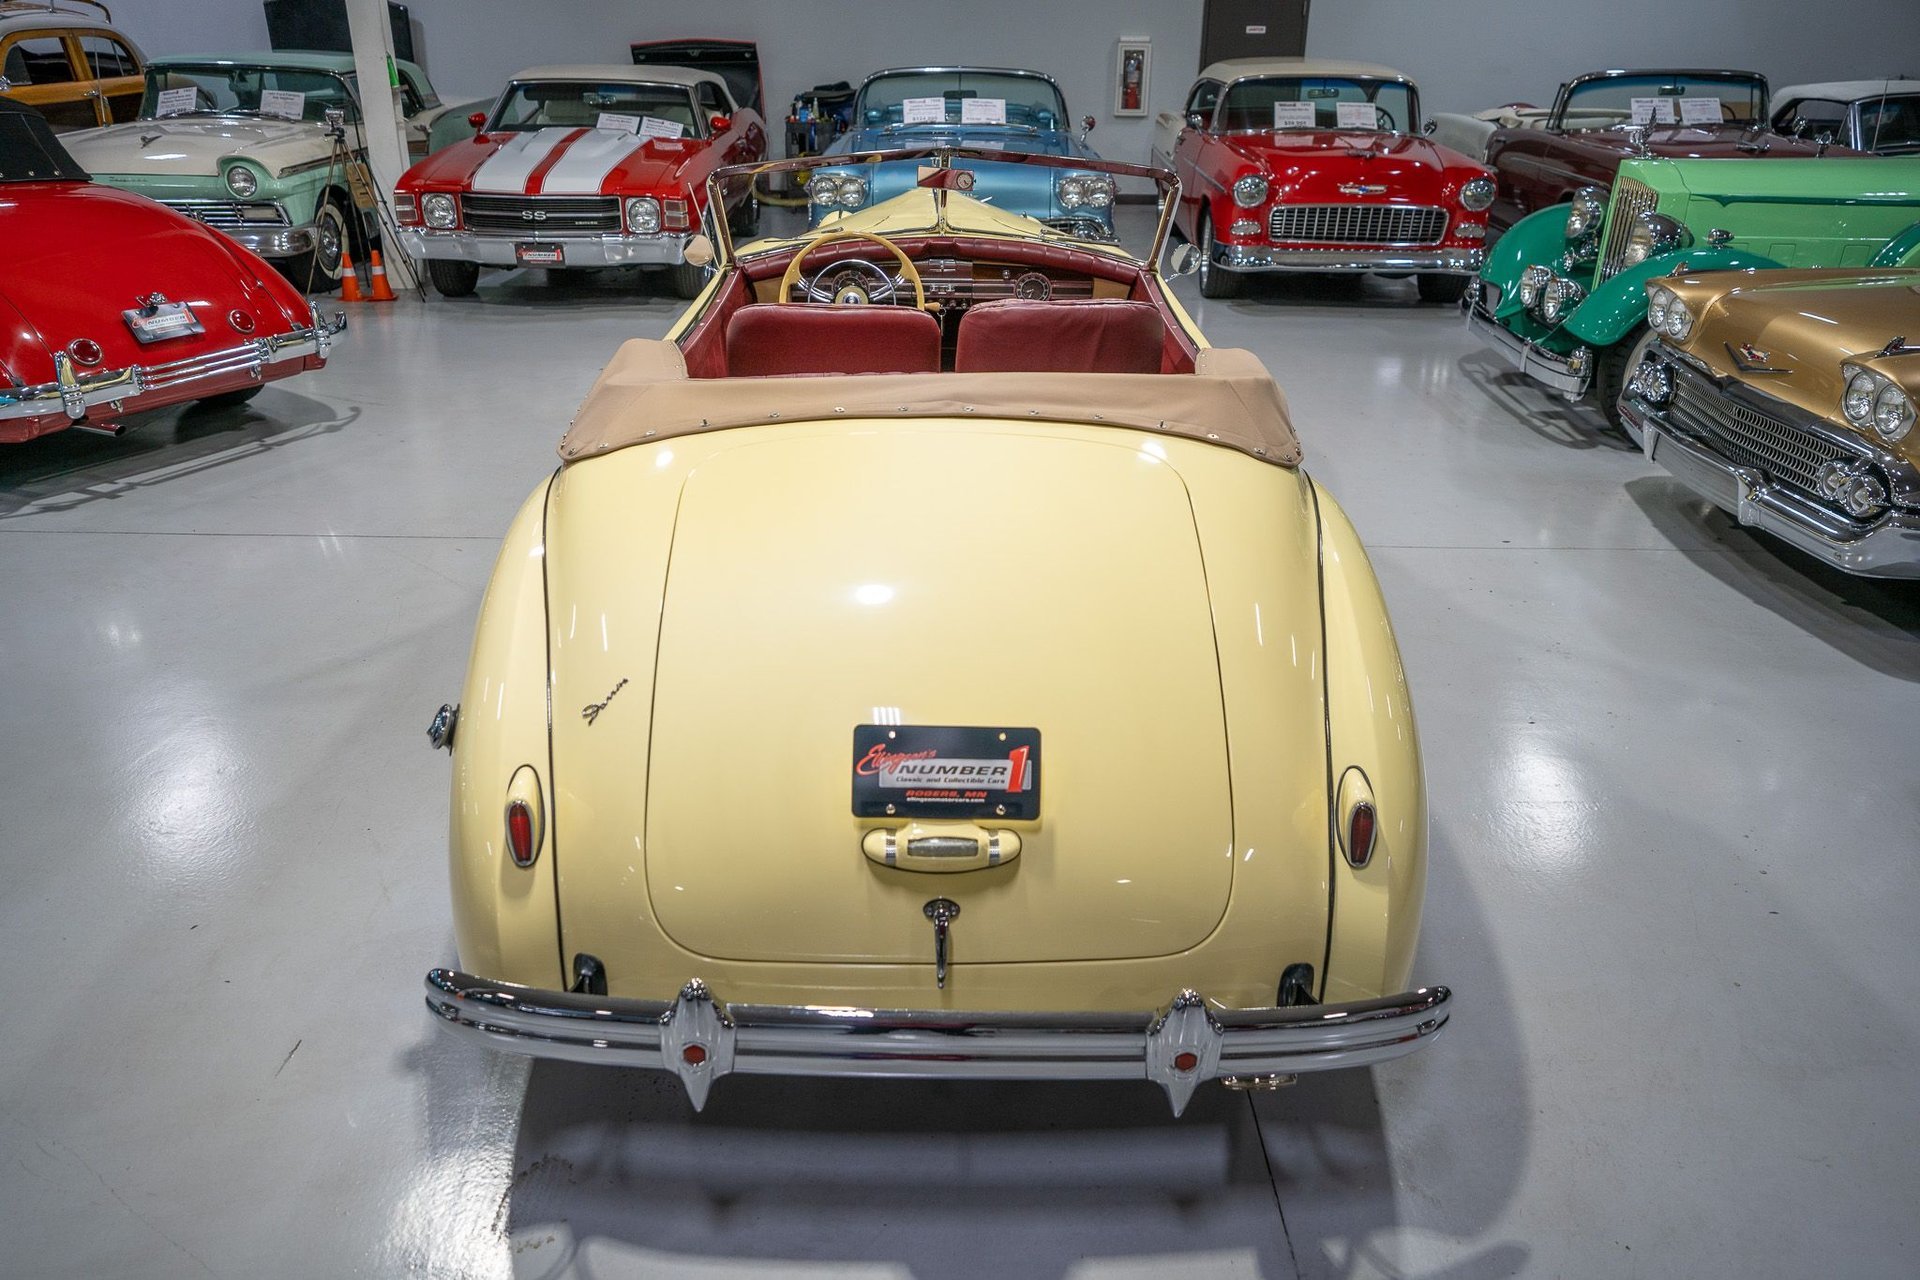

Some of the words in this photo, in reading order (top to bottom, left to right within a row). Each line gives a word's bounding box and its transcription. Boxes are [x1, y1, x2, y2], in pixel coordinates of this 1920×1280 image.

[522, 211, 546, 220] SS
[898, 765, 1007, 776] NUMBER
[1006, 745, 1030, 793] 1
[964, 790, 988, 799] MN
